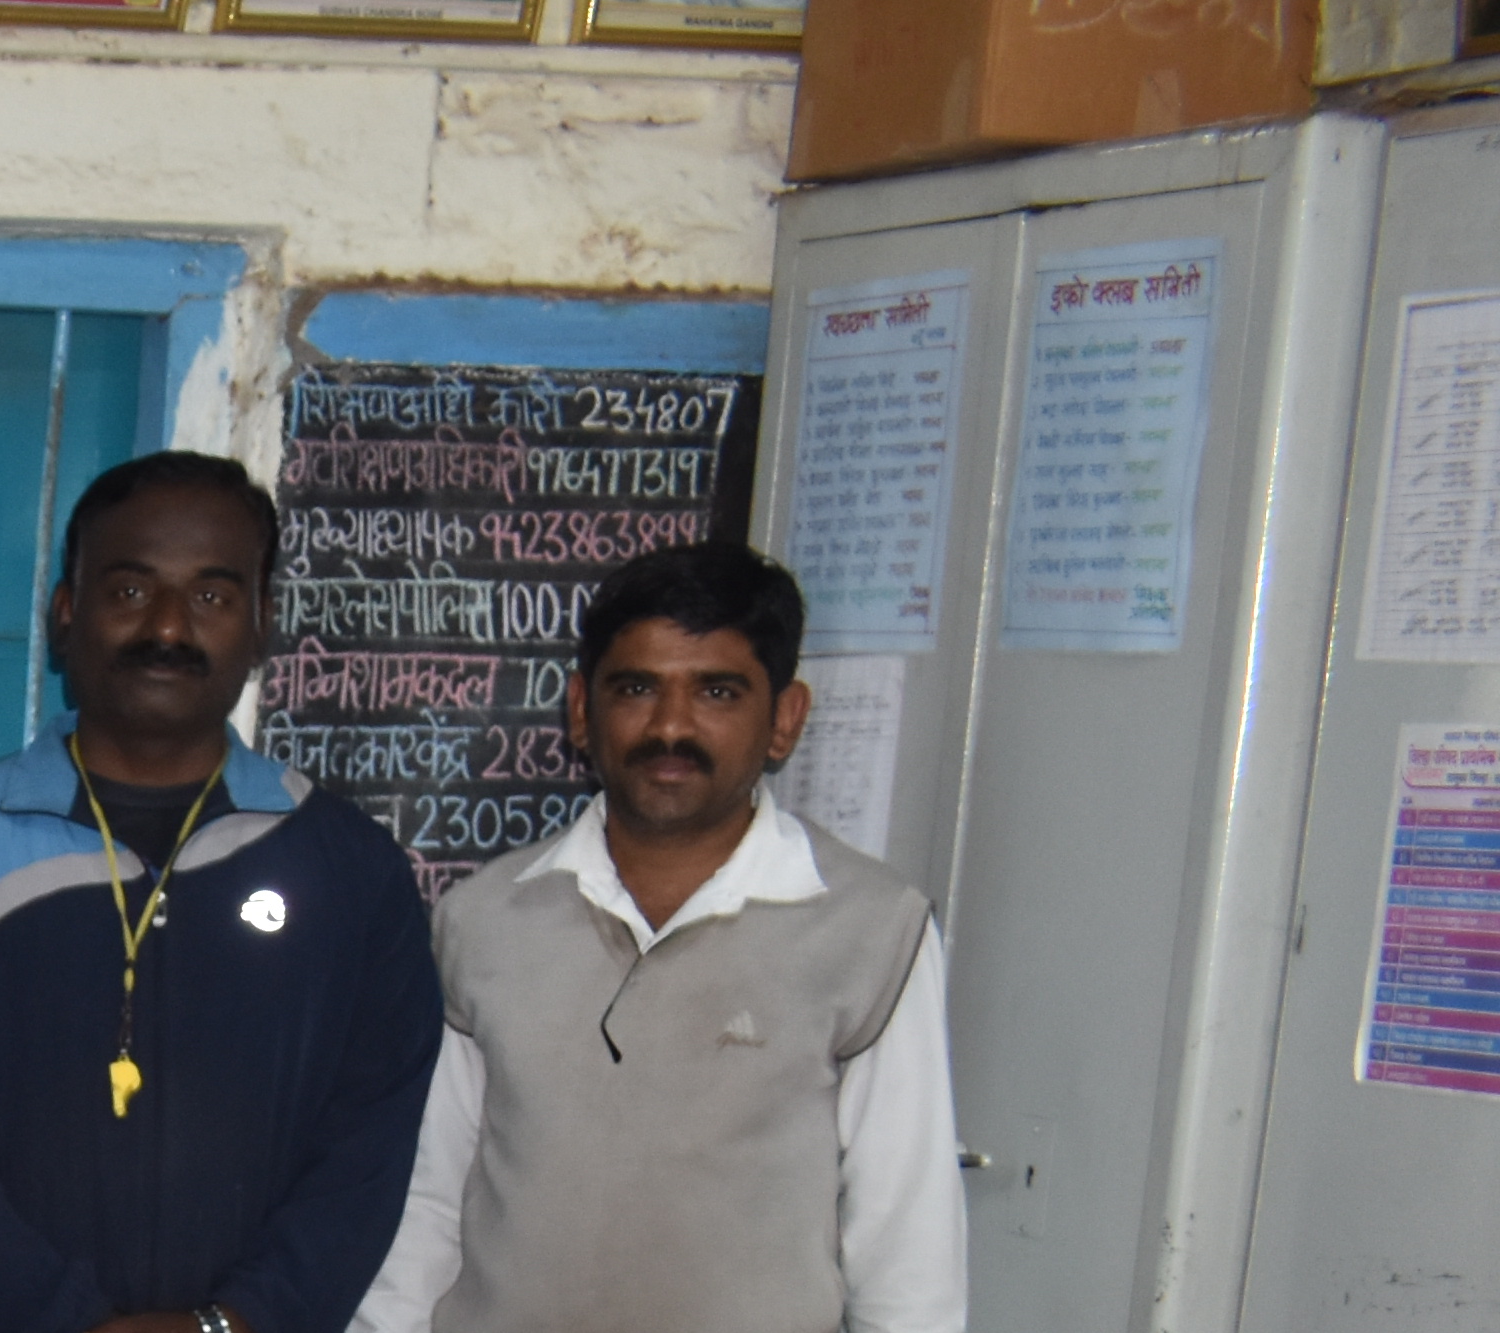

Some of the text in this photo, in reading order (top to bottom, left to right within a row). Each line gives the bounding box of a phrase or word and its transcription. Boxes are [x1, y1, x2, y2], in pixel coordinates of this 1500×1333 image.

[1050, 274, 1090, 316] इको
[1144, 262, 1202, 303] समिती
[575, 384, 734, 437] 234807
[498, 581, 601, 640] 100-0
[522, 656, 579, 710] 10
